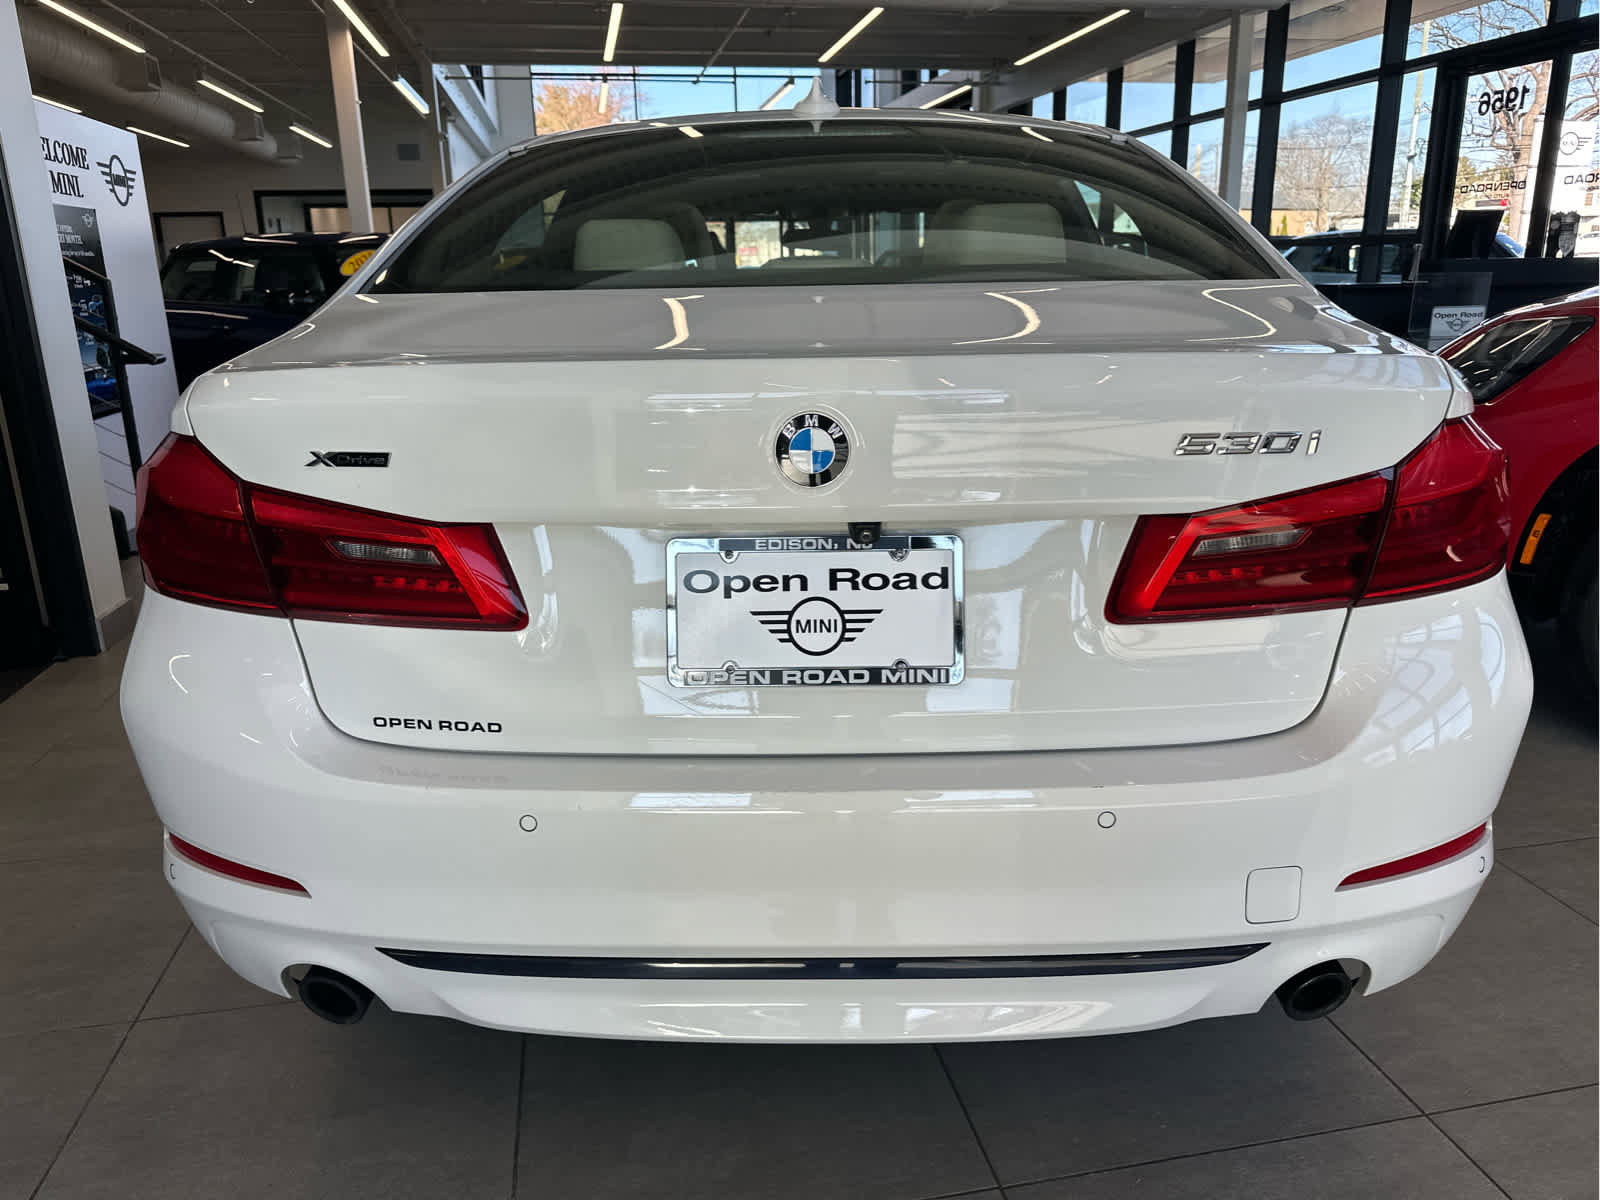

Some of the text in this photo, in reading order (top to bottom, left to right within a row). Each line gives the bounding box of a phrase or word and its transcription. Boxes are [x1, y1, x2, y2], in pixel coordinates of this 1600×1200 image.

[40, 136, 90, 170] ELCOME
[782, 414, 843, 440] BMW
[754, 538, 839, 550] EDISON,
[683, 566, 949, 599] Open Road
[795, 618, 838, 634] MINI
[687, 668, 947, 686] OPEN ROAD MINI
[373, 716, 502, 733] OPEN ROAD
